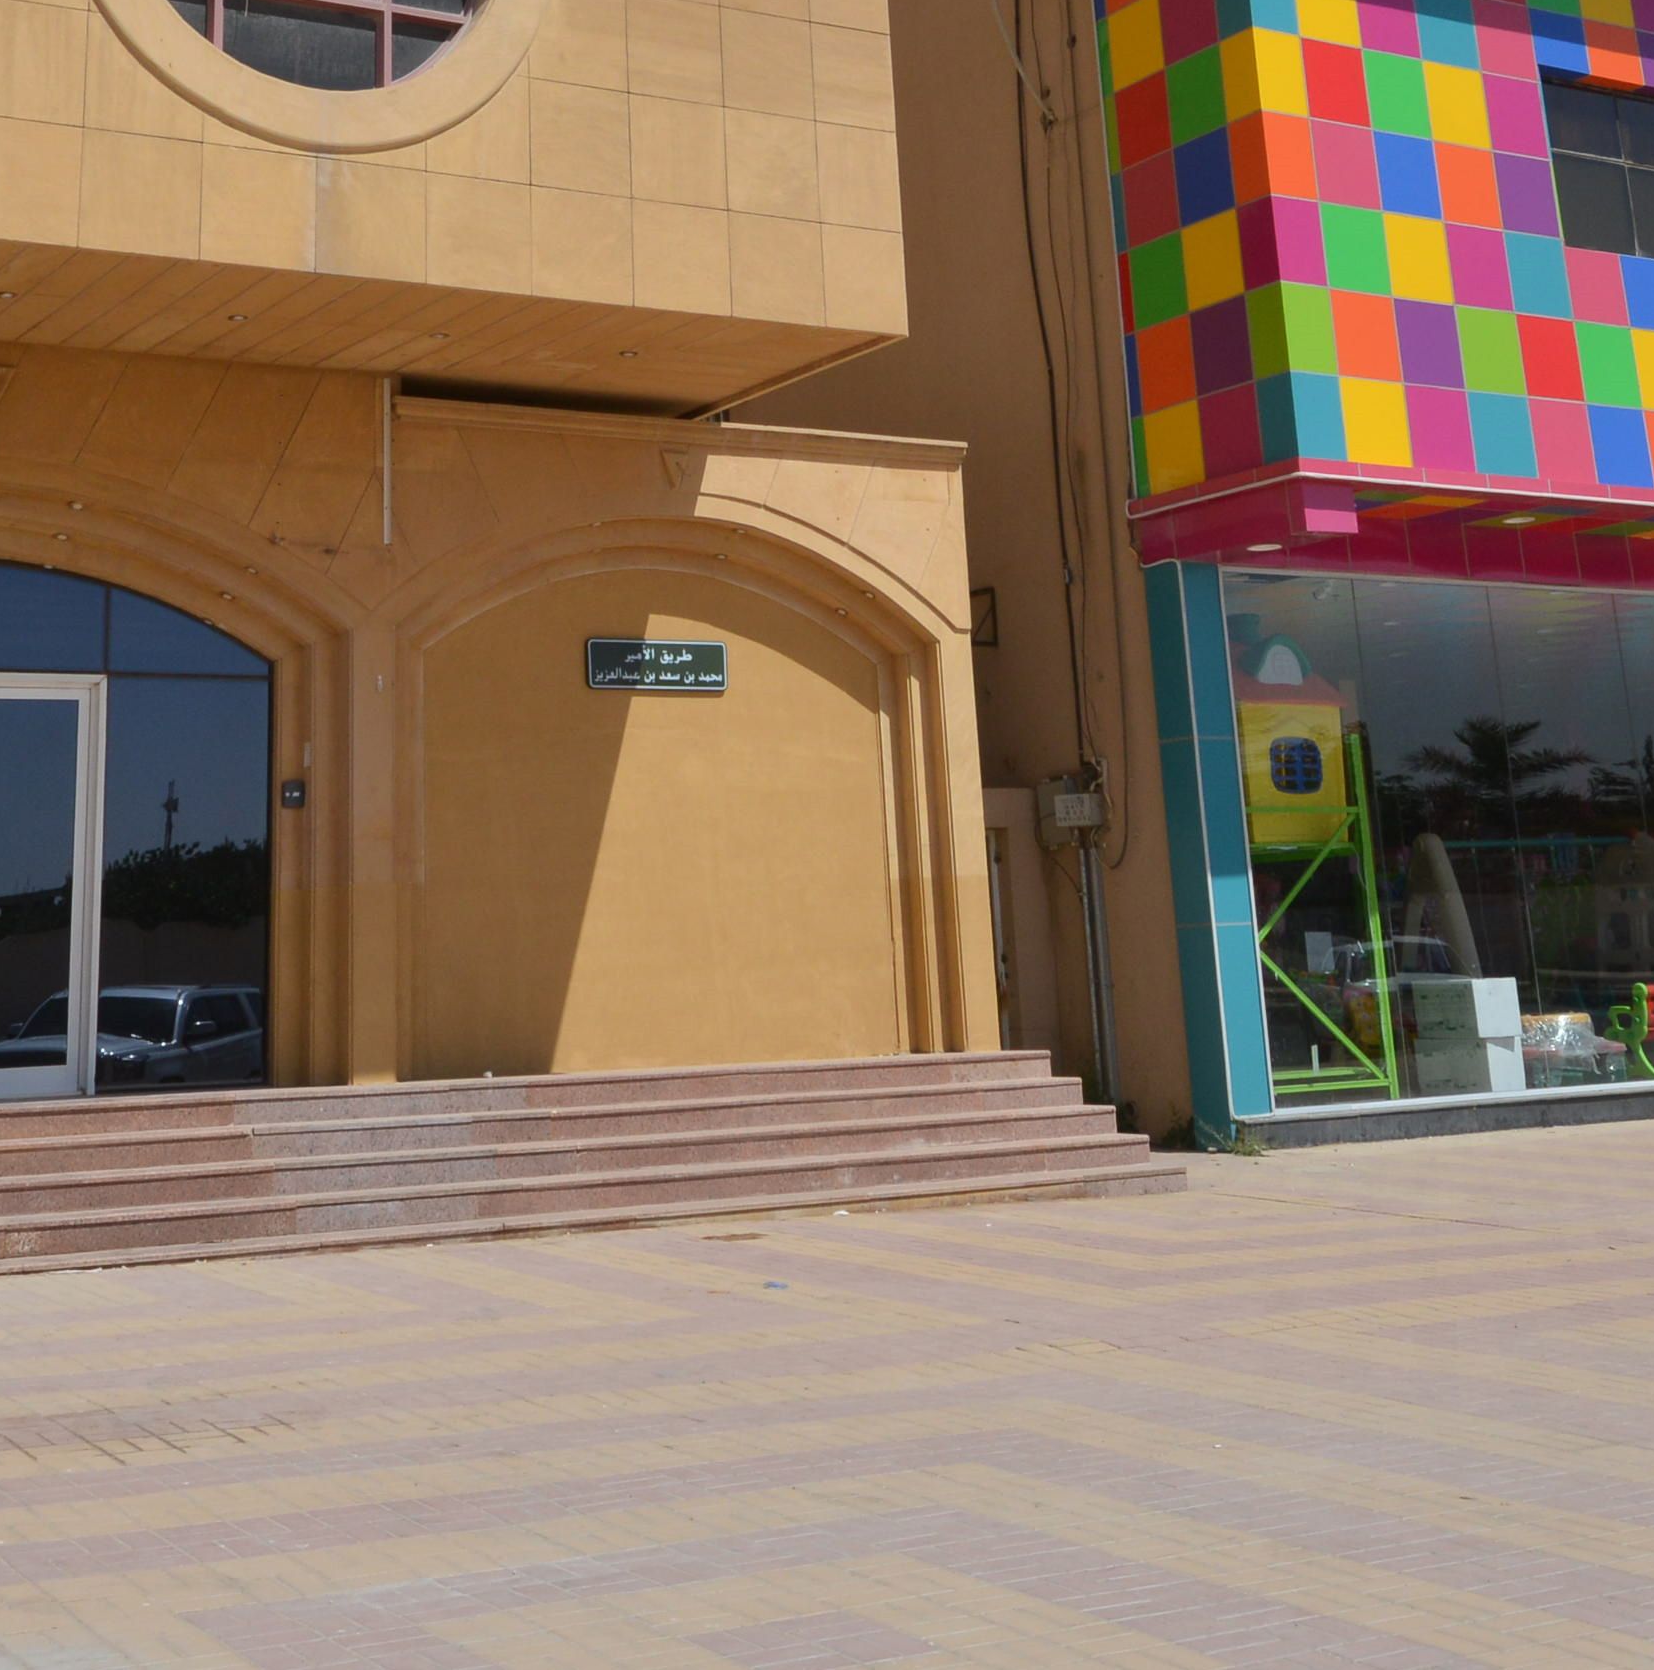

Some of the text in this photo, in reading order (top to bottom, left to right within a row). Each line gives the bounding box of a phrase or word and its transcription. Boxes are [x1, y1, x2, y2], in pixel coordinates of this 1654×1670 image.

[624, 644, 693, 665] طريق الأمير
[643, 669, 656, 684] بن
[659, 671, 681, 682] سعد
[683, 670, 696, 684] بن
[698, 672, 723, 683] محمد
